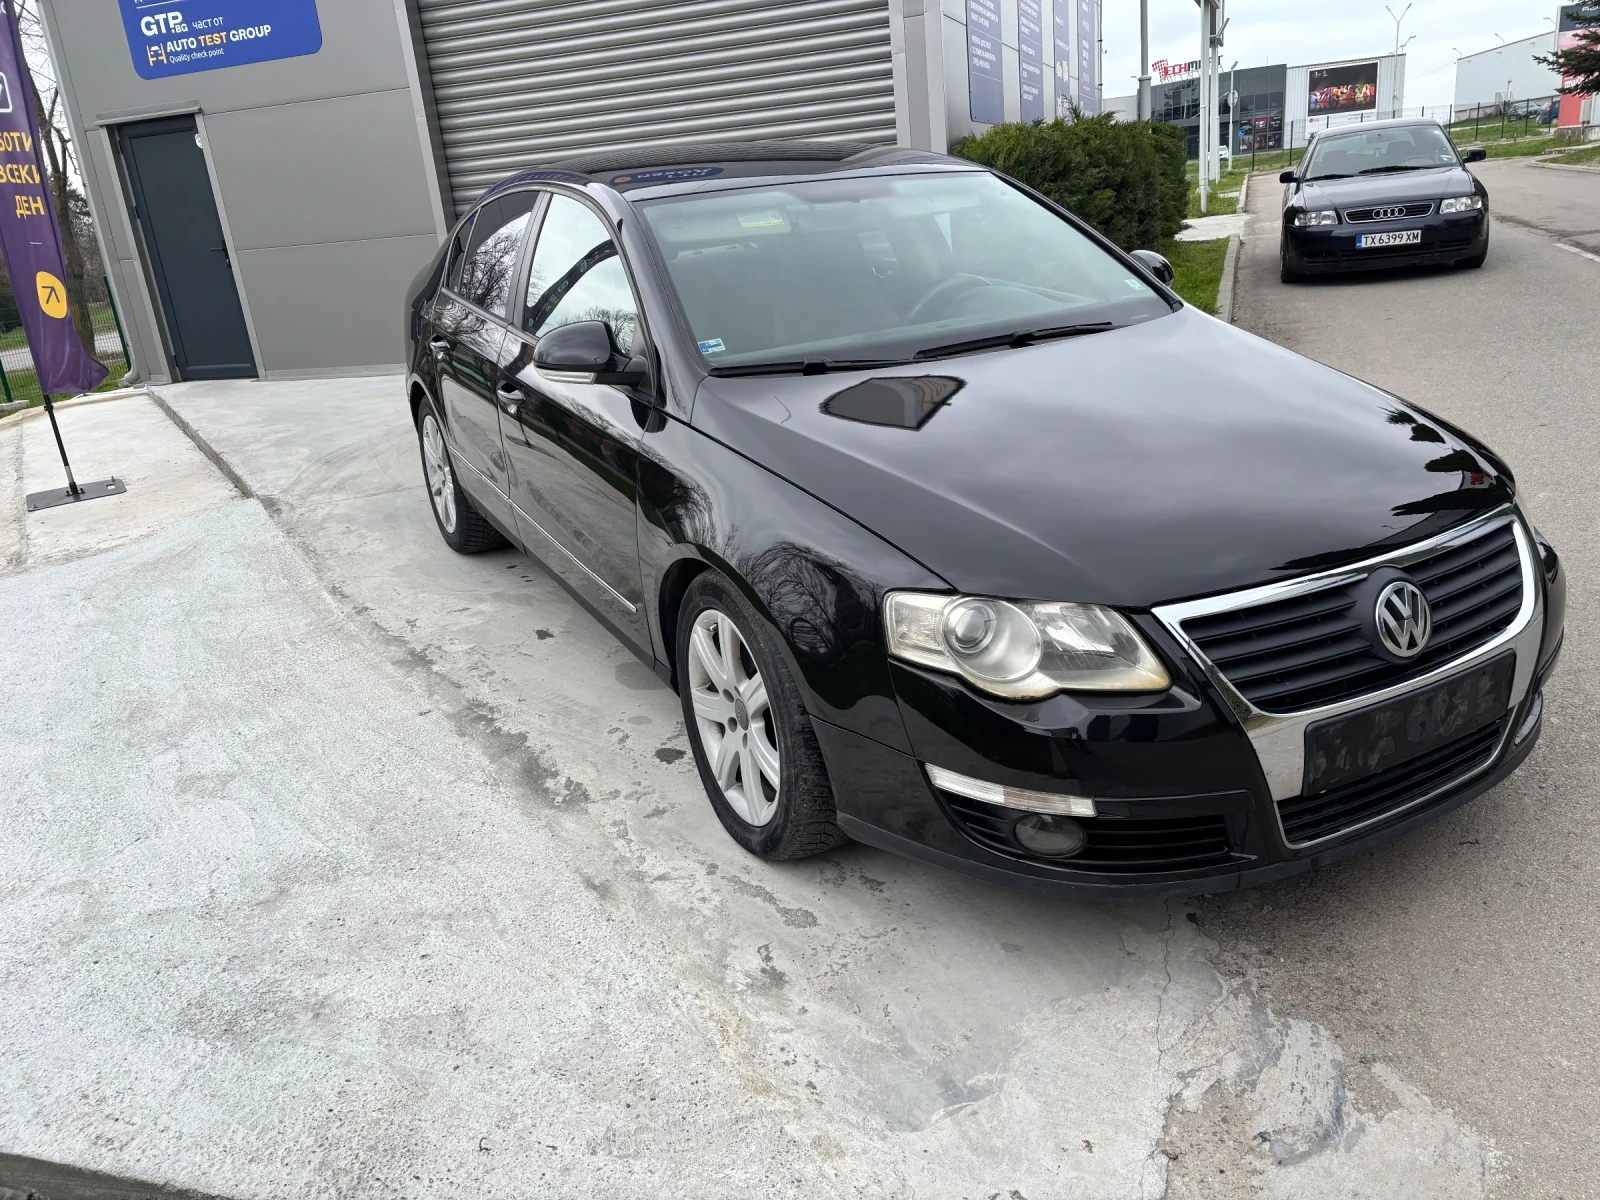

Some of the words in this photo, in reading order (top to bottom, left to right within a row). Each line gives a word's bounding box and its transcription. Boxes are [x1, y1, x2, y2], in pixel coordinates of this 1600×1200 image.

[192, 18, 212, 30] част
[213, 17, 224, 26] от
[166, 37, 197, 53] AUTO
[198, 32, 227, 47] TEST
[229, 24, 272, 42] GROUP
[169, 53, 190, 64] Quality
[191, 49, 208, 60] check
[208, 47, 225, 58] point
[14, 194, 46, 219] ДЕН
[1363, 234, 1377, 246] TX
[1378, 232, 1404, 245] 6399
[1405, 231, 1420, 243] XM
[1376, 582, 1430, 657] VW
